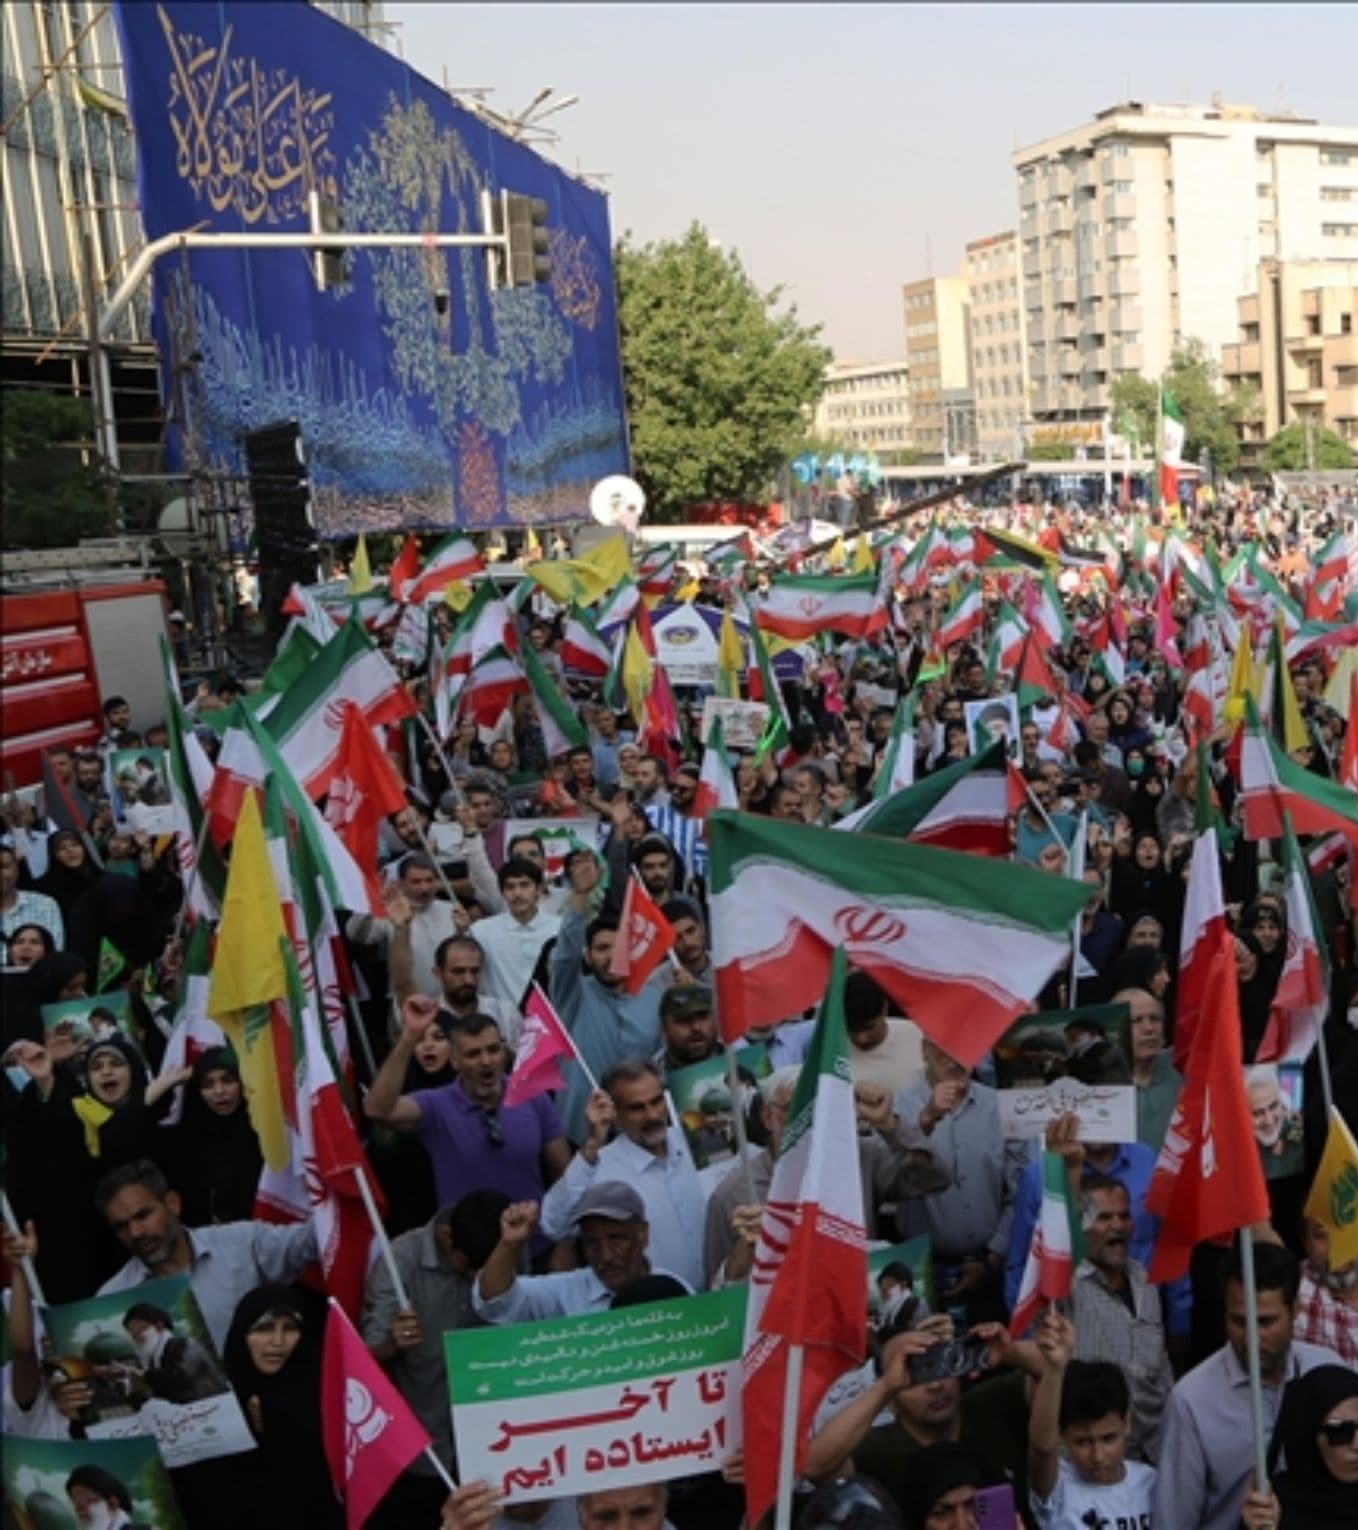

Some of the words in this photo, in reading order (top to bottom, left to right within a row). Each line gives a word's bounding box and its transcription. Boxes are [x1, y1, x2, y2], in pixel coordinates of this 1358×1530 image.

[488, 1377, 679, 1452] آخر
[695, 1369, 728, 1405] تا
[503, 1444, 567, 1496] ایم
[583, 1415, 726, 1473] ایستاده
